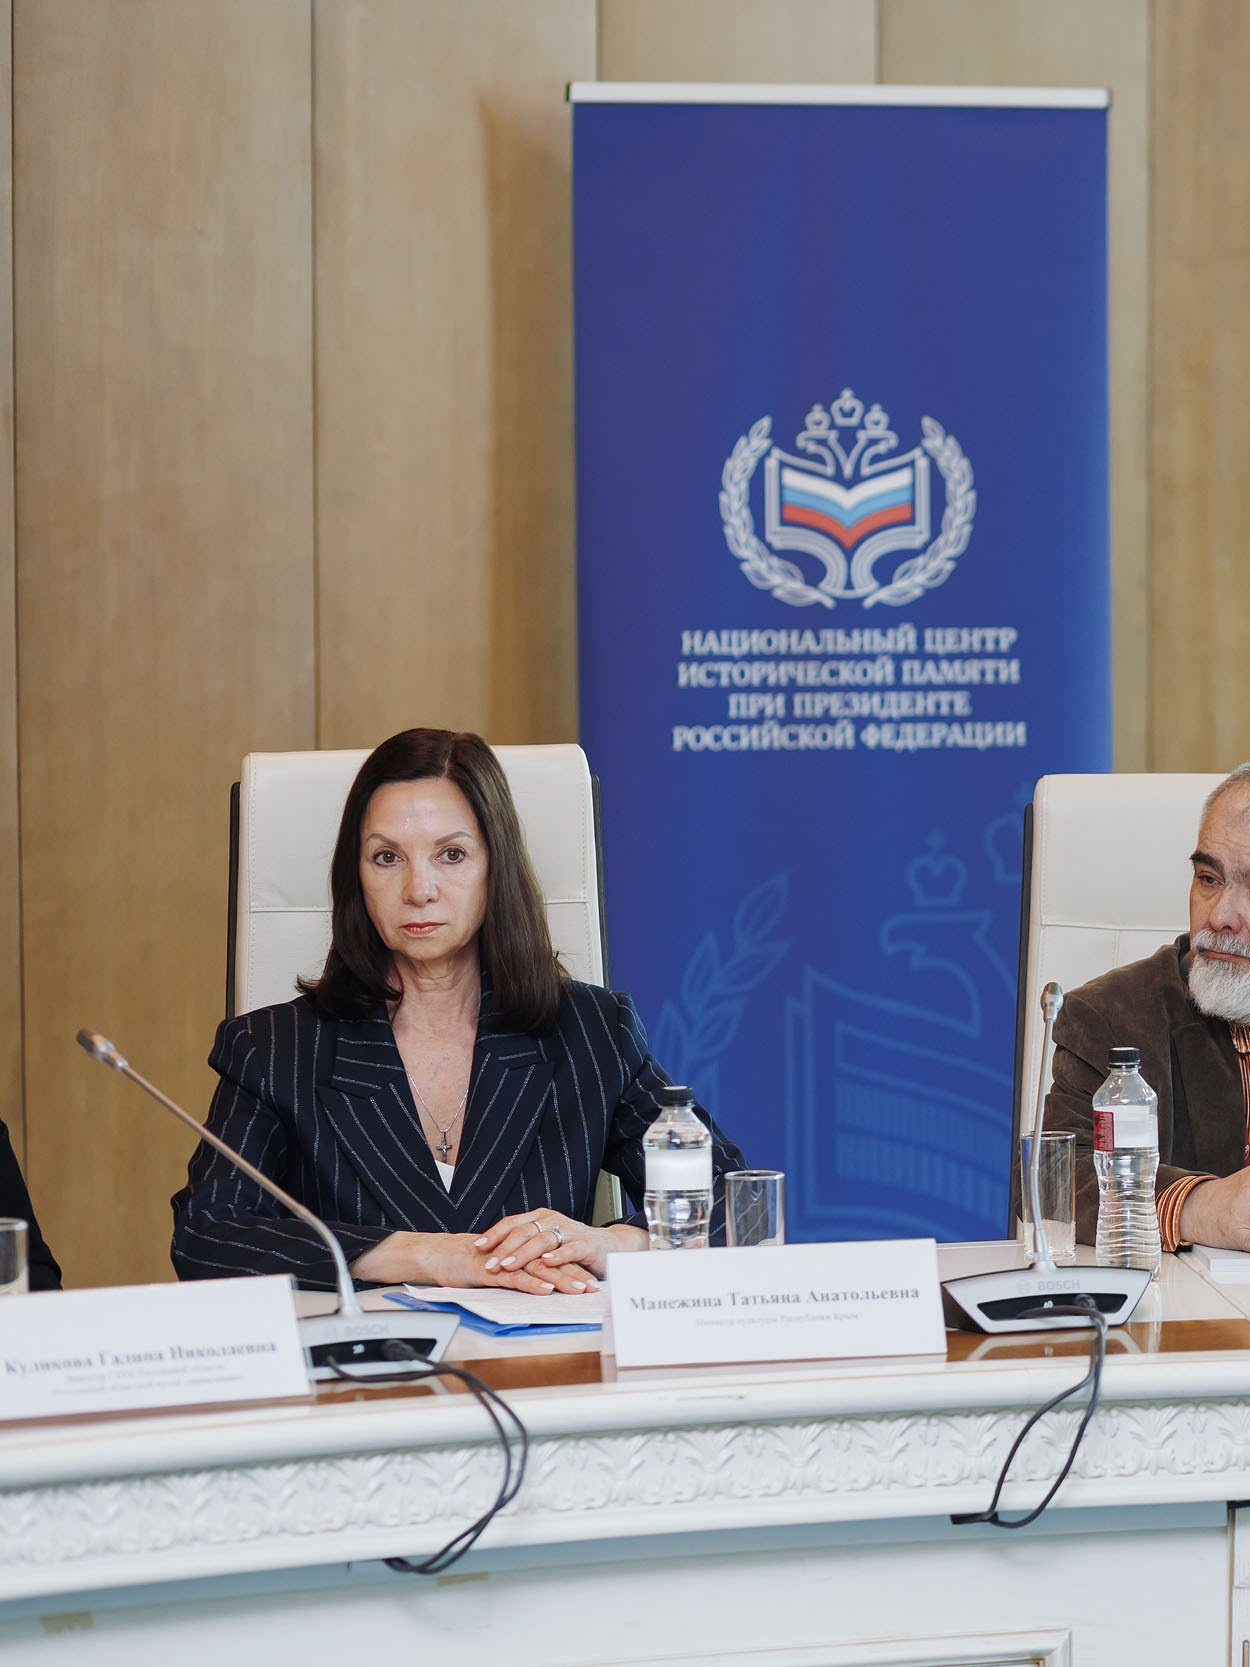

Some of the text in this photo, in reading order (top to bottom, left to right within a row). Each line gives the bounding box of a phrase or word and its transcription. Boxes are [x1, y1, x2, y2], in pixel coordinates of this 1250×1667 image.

[681, 623, 1018, 656] НАЦИОНАЛЬНЫЙ ЦЕНТР
[677, 656, 1020, 688] ИСТОРИЧЕСКОЙ ПАМЯТИ
[729, 692, 970, 720] ПРИ ПРЕЗИДЕНТЕ
[673, 721, 1026, 751] РОССИЙСКОЙ ФЕДЕРАЦИИ
[1037, 1279, 1080, 1290] BOSCH
[629, 1287, 920, 1313] Манежина Татьяна Анатольевна
[99, 1351, 164, 1367] Галина
